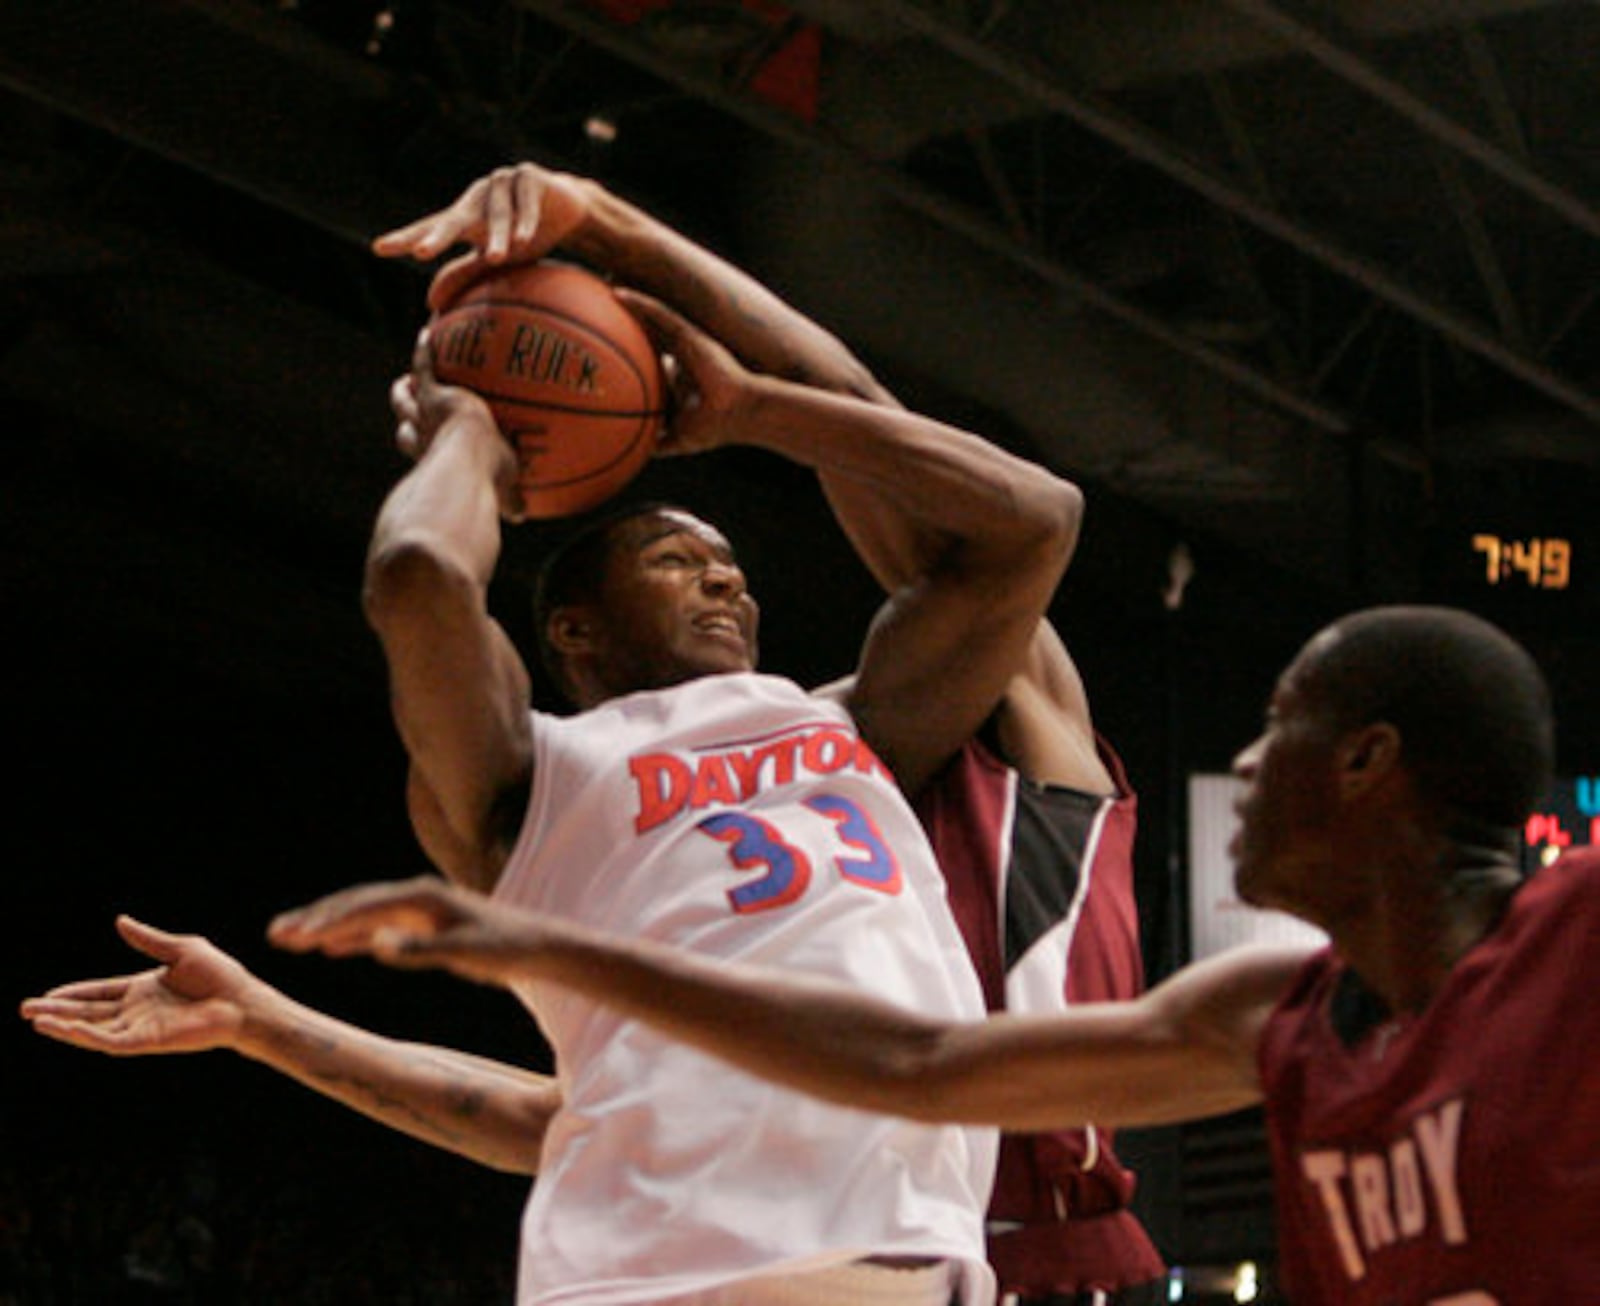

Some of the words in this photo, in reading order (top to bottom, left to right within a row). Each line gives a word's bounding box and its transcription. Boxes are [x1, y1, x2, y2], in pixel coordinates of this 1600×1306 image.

[1472, 534, 1570, 589] 7:49
[696, 795, 903, 915] 33
[1302, 1100, 1467, 1280] TROY
